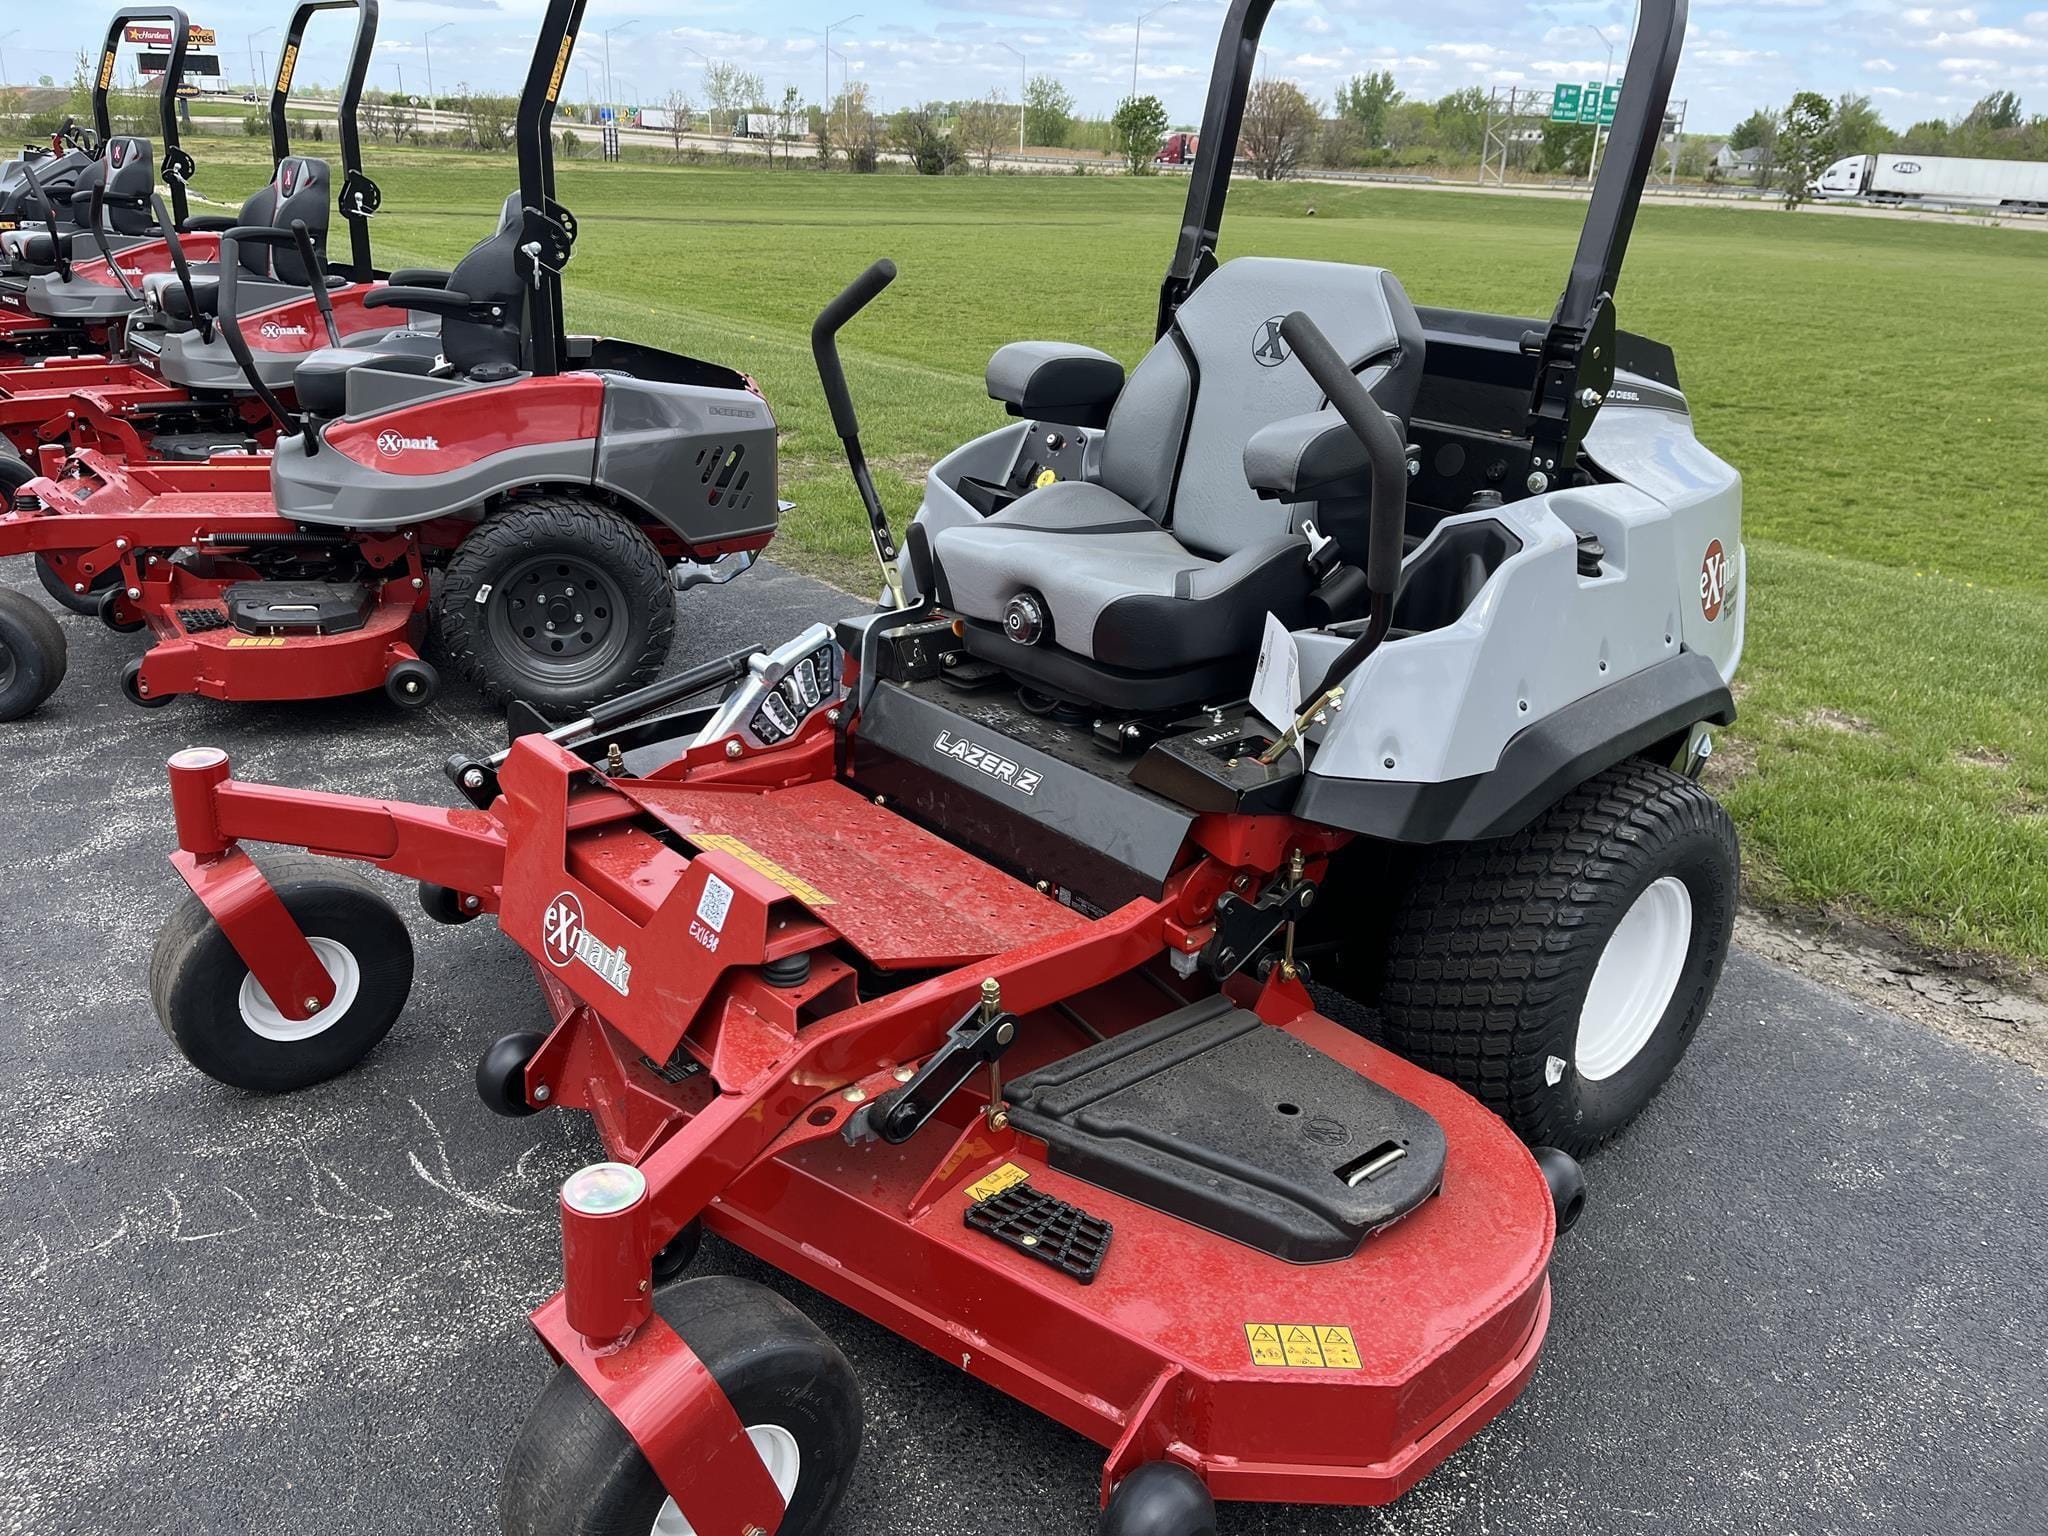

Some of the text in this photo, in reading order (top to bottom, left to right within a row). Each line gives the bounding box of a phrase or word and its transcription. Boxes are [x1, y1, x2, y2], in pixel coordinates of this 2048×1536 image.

[1616, 390, 1640, 402] DIESEL
[377, 431, 440, 452] eXmark
[934, 730, 1044, 796] LAZER Z
[543, 896, 632, 993] eXmark
